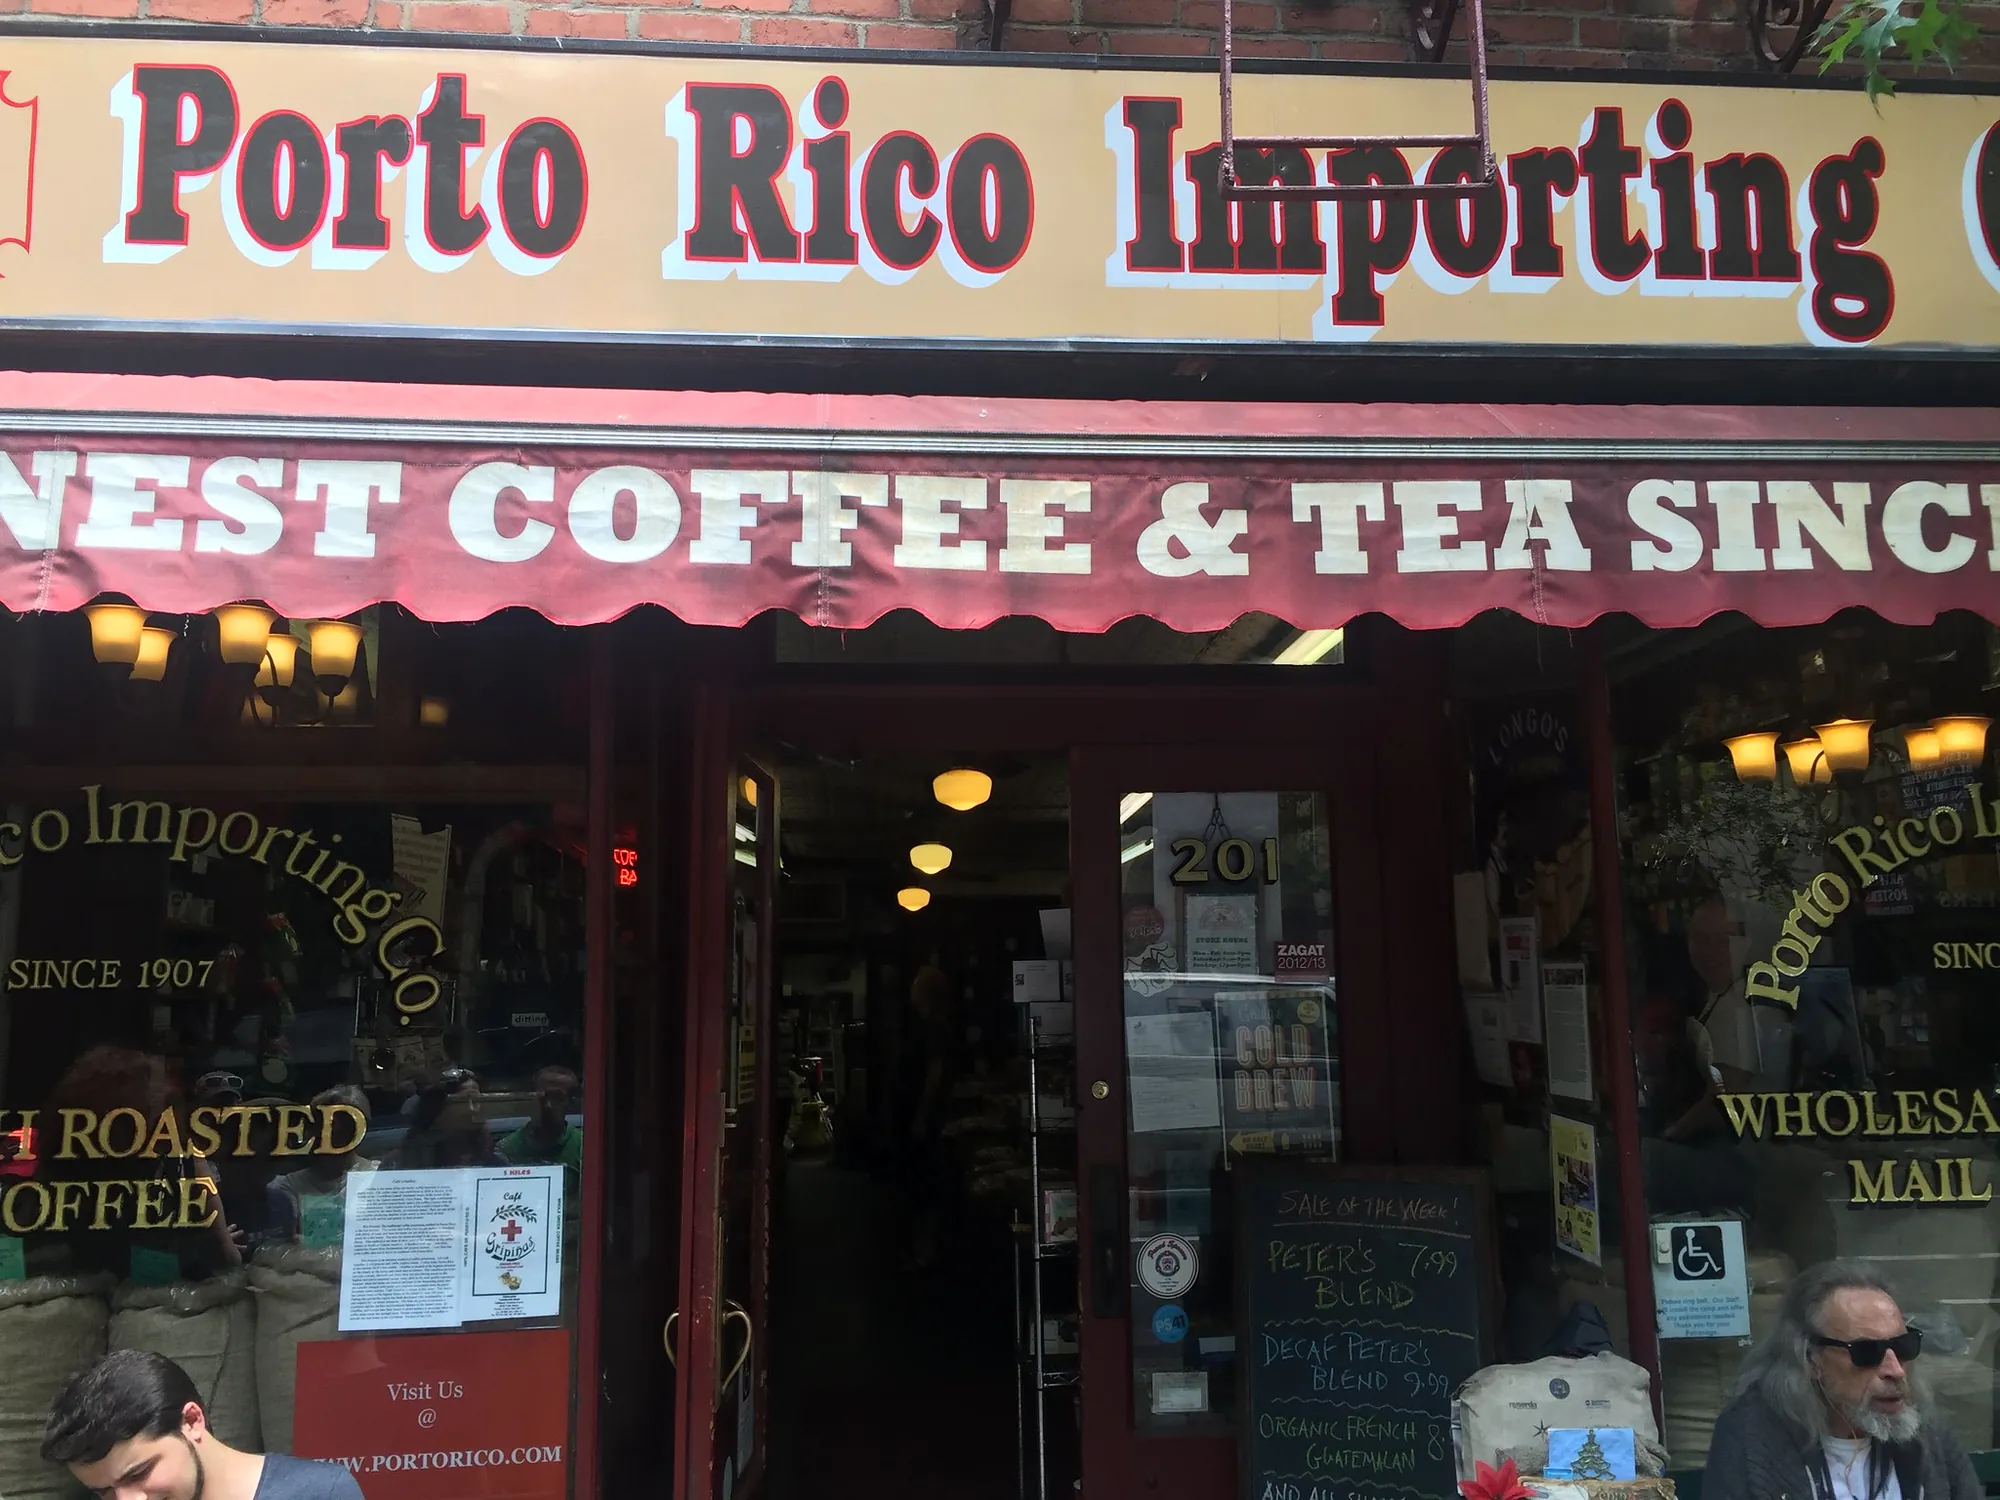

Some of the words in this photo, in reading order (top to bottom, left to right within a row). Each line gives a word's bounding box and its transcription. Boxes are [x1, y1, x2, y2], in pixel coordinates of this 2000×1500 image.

[103, 63, 588, 276] Porto
[662, 76, 1034, 290] Rico
[1105, 96, 1895, 347] Importing
[0, 450, 403, 558] NEST
[449, 459, 1093, 577] COFFEE
[1136, 481, 1250, 577] &
[1291, 480, 1592, 576] TEA
[1628, 479, 2000, 574] SINC
[614, 849, 637, 866] COF
[1169, 837, 1279, 886] 201
[81, 784, 401, 946] Importing
[377, 916, 447, 1026] Co.
[1745, 871, 1851, 1010] Porto
[1830, 804, 1963, 888] Rico
[1277, 944, 1325, 957] ZAGAT
[1277, 957, 1326, 970] 2012/13
[7, 959, 121, 990] SINCE
[137, 959, 214, 988] 1907
[1235, 1024, 1312, 1067] COLD
[1234, 1067, 1317, 1111] BREW
[53, 1102, 367, 1160] ROASTED
[1716, 1088, 2000, 1139] WHOLESA
[1848, 1157, 1993, 1204] MAIL
[1, 1177, 219, 1232] OFFEE
[1278, 1190, 1331, 1218] SALE
[1337, 1197, 1361, 1215] OF
[1364, 1197, 1397, 1219] THE
[1268, 1237, 1377, 1275] PETER'S
[1398, 1242, 1458, 1279] 7.99
[1304, 1274, 1416, 1310] BLEND
[1261, 1332, 1338, 1367] DECAF
[1340, 1331, 1432, 1367] PETER'S
[387, 1381, 432, 1401] Visit
[438, 1381, 463, 1399] Us
[1310, 1364, 1389, 1392] BLEND
[1404, 1371, 1449, 1398] 9.99
[417, 1408, 437, 1429] @
[1259, 1412, 1342, 1441] ORGANIC
[1346, 1415, 1418, 1442] FRENCH
[313, 1445, 562, 1473] W.PORTORICO.COM
[1306, 1443, 1416, 1474] GUATEMALAN
